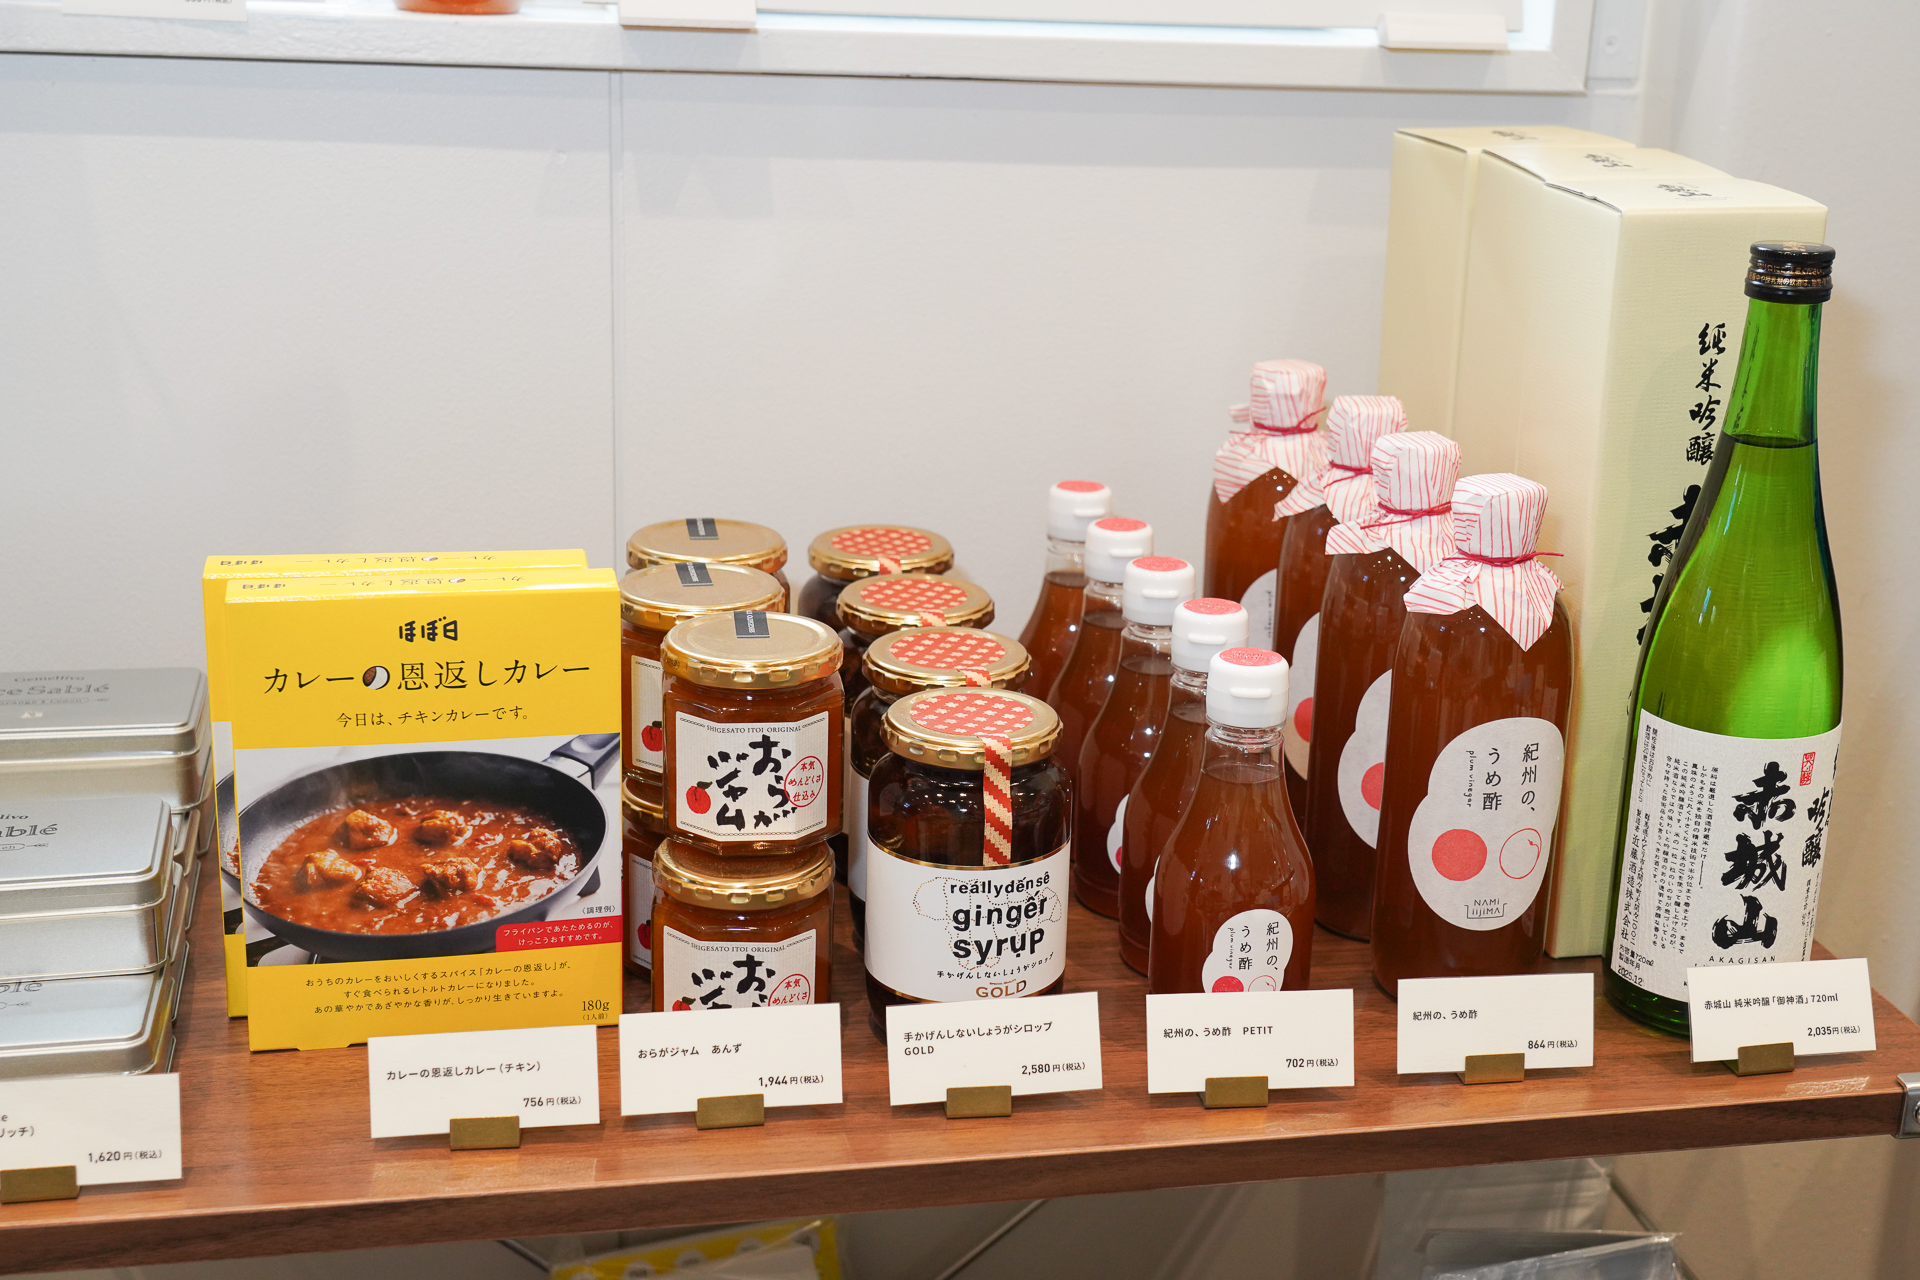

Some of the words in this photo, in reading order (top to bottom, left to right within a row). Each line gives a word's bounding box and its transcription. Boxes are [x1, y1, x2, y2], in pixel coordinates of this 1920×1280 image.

[398, 615, 459, 643] ほぼ日
[336, 704, 529, 728] 今日は、チキンカレーです。
[706, 723, 746, 734] SHIGESATO
[766, 724, 801, 734] ORIGINAL
[1466, 750, 1477, 772] plum
[749, 734, 798, 829] おらが
[1482, 747, 1503, 811] うめ酢
[1520, 742, 1540, 812] 紀州の、
[706, 750, 748, 832] ジャム
[1463, 773, 1475, 808] vinegar
[1711, 761, 1797, 950] 赤城山
[503, 920, 614, 938] フライパンであたためるのが、
[518, 932, 603, 947] けっこうおすすめです。
[690, 942, 730, 953] SHIGESATO
[751, 944, 786, 953] ORIGINAL
[1238, 925, 1253, 971] うめ酢
[1266, 921, 1280, 971] 紀州の、
[305, 959, 572, 988] おうちのカレーをおいしくするスパイス「カレーの恩返し」が、
[784, 978, 802, 990] 本気
[343, 978, 536, 999] すぐ食べられるレトルトカレーになりました。
[975, 980, 1027, 998] GOLD
[314, 989, 565, 1015] あの華やかであざやかな香りが、しっかり生きていますよ。
[580, 999, 611, 1013] 180g
[1704, 998, 1732, 1010] 赤城山
[1412, 1008, 1478, 1022] 紀州の、うめ酢
[903, 1021, 1054, 1042] 手かげんしないしょうがシロップ
[1163, 1026, 1232, 1039] 紀州の、うめ酢
[1242, 1025, 1274, 1036] PETIT
[637, 1045, 701, 1060] おらがジャム
[711, 1042, 743, 1055] あんず
[904, 1045, 935, 1056] GOLD
[386, 1060, 542, 1082] カレーの恩返しカレー（チキン）
